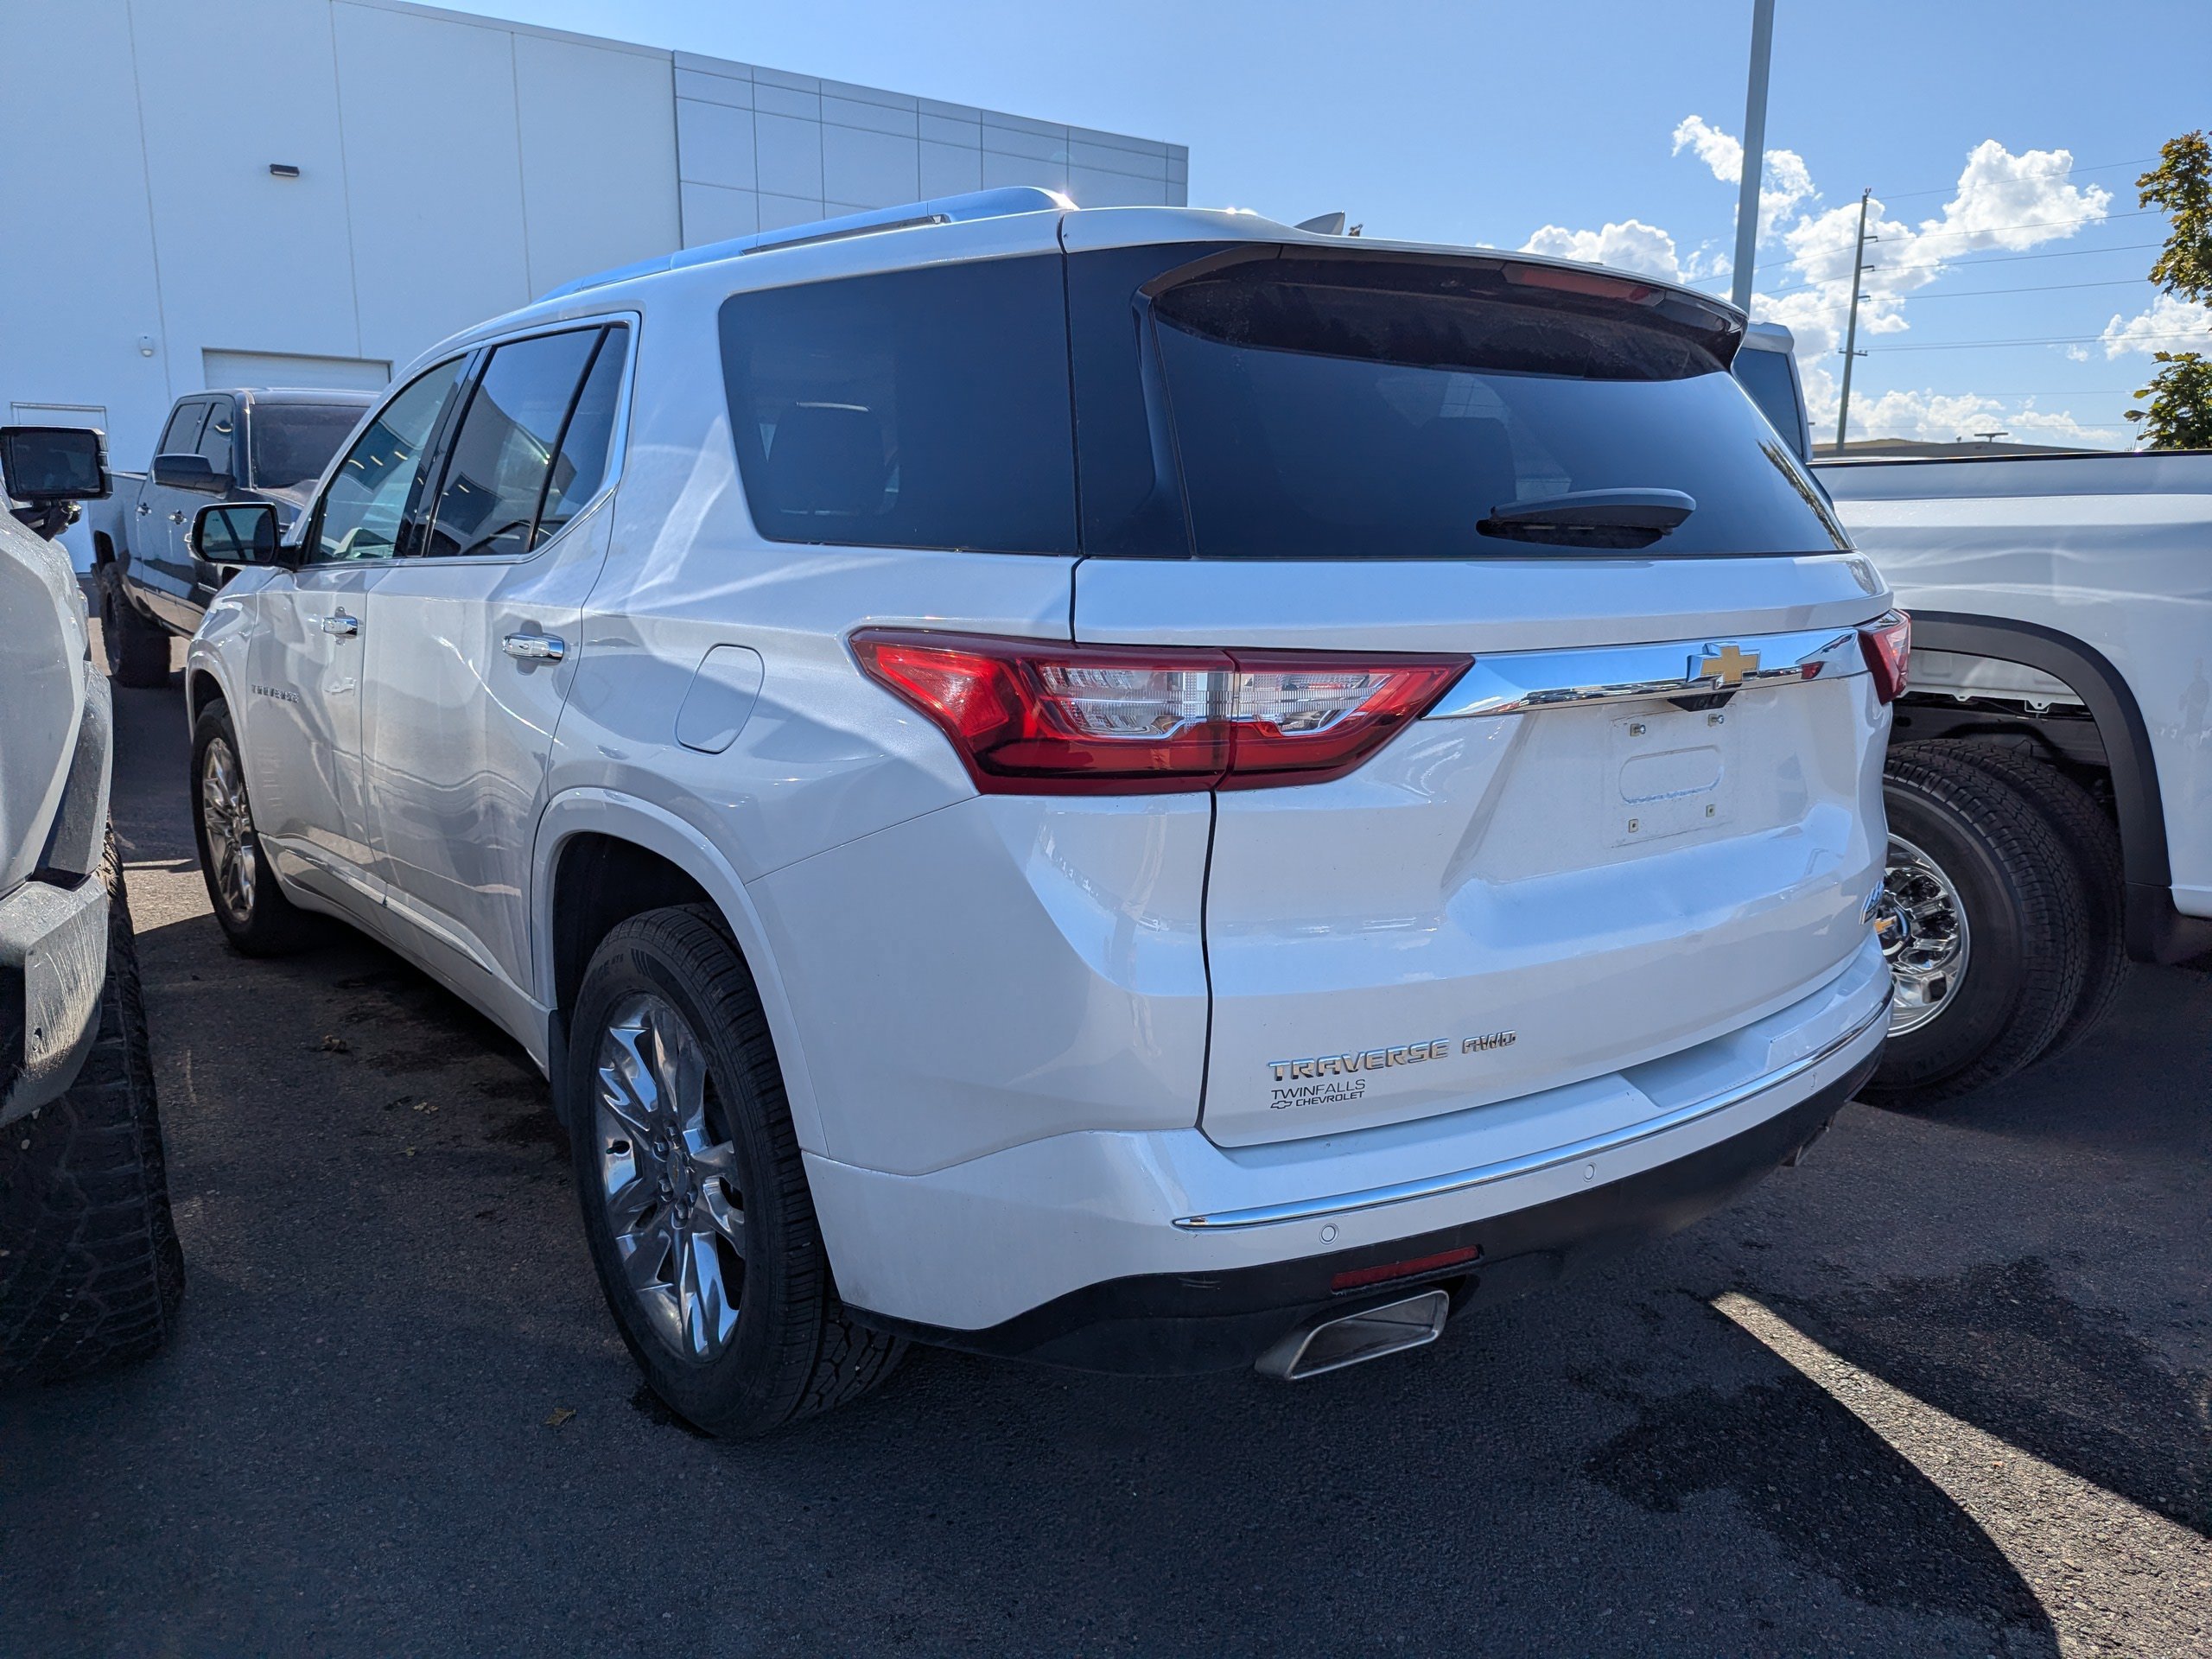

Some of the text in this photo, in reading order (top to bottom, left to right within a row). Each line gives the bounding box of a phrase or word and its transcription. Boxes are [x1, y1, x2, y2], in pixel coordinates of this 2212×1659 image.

[1268, 1029, 1516, 1081] TRAVERSE AWD
[1296, 1090, 1364, 1107] CHEVROLET
